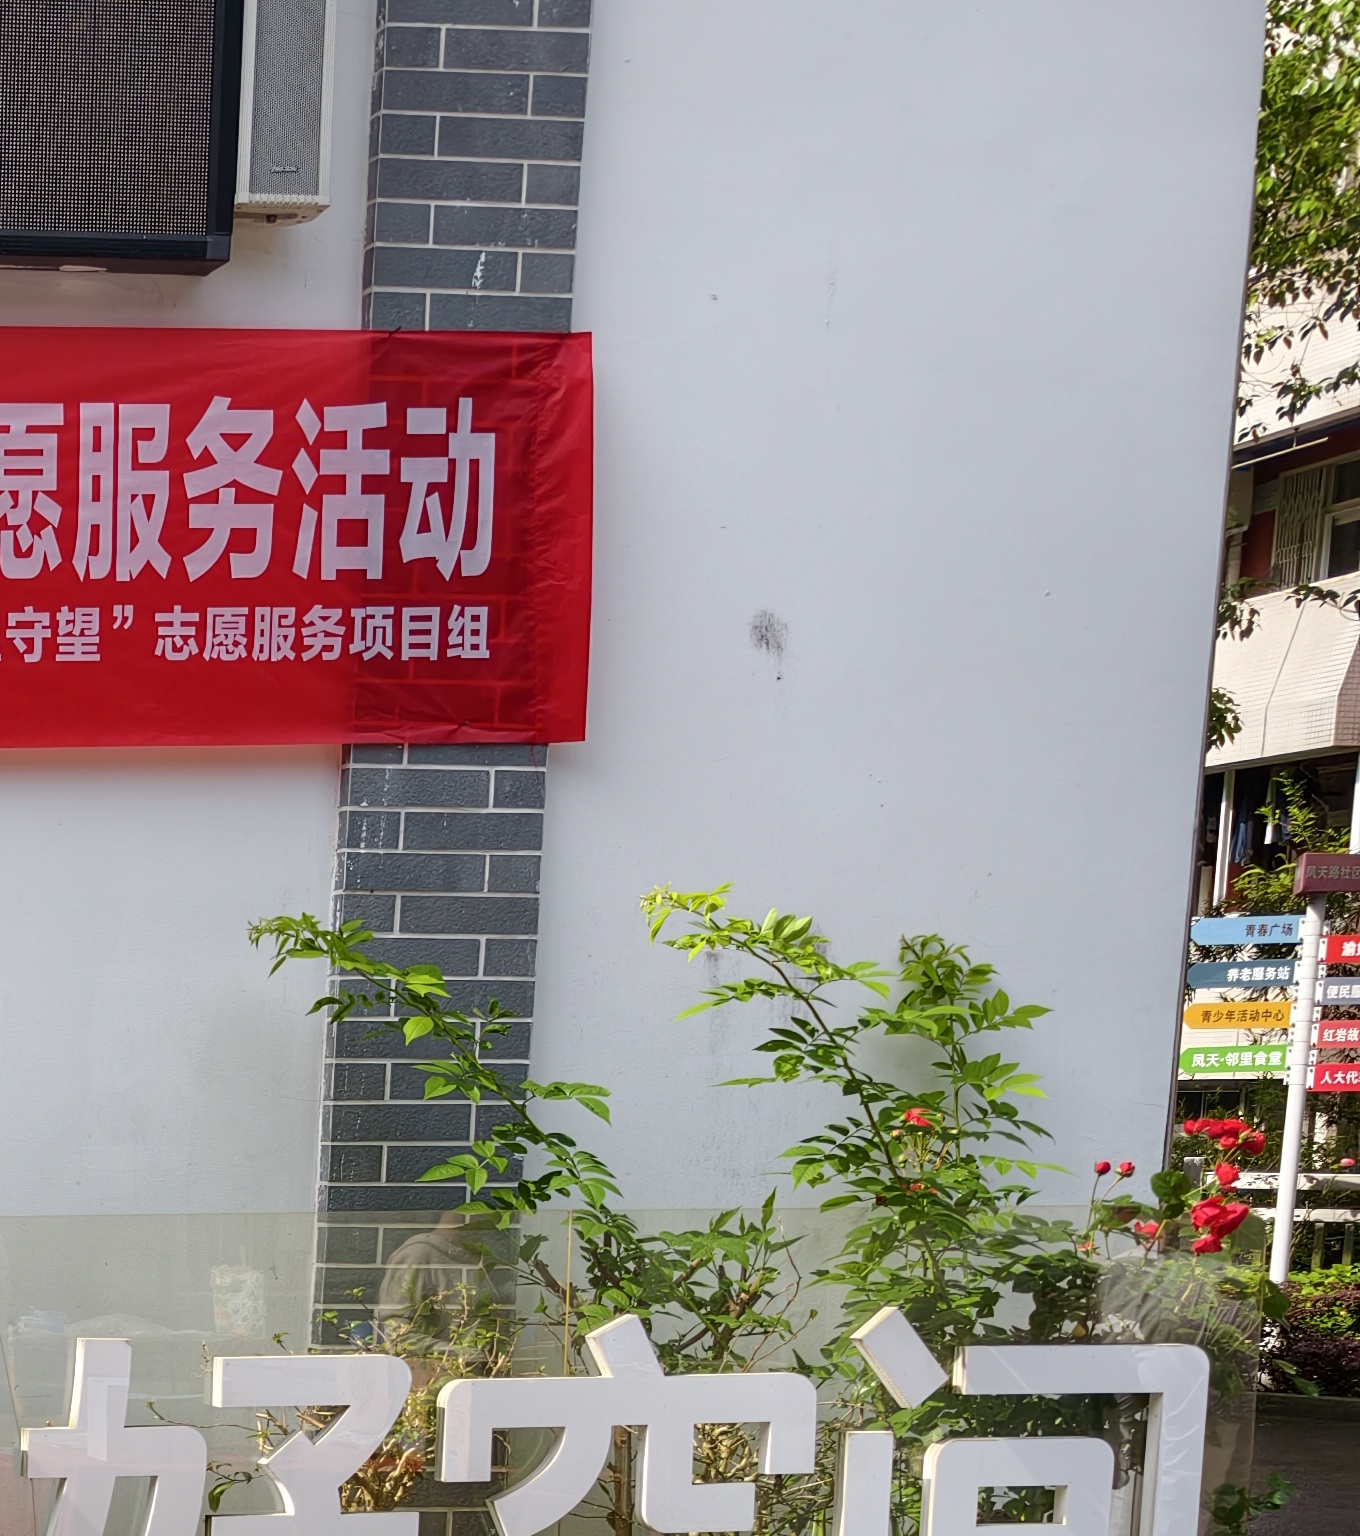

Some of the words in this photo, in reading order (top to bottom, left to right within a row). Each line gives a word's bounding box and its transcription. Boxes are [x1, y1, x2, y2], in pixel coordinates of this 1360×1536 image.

[1245, 923, 1293, 938] 青春广场
[1227, 966, 1291, 982] 养老服务站
[1201, 1009, 1285, 1023] 青少年活动中心
[1191, 1051, 1283, 1068] 凤天·邻里食堂
